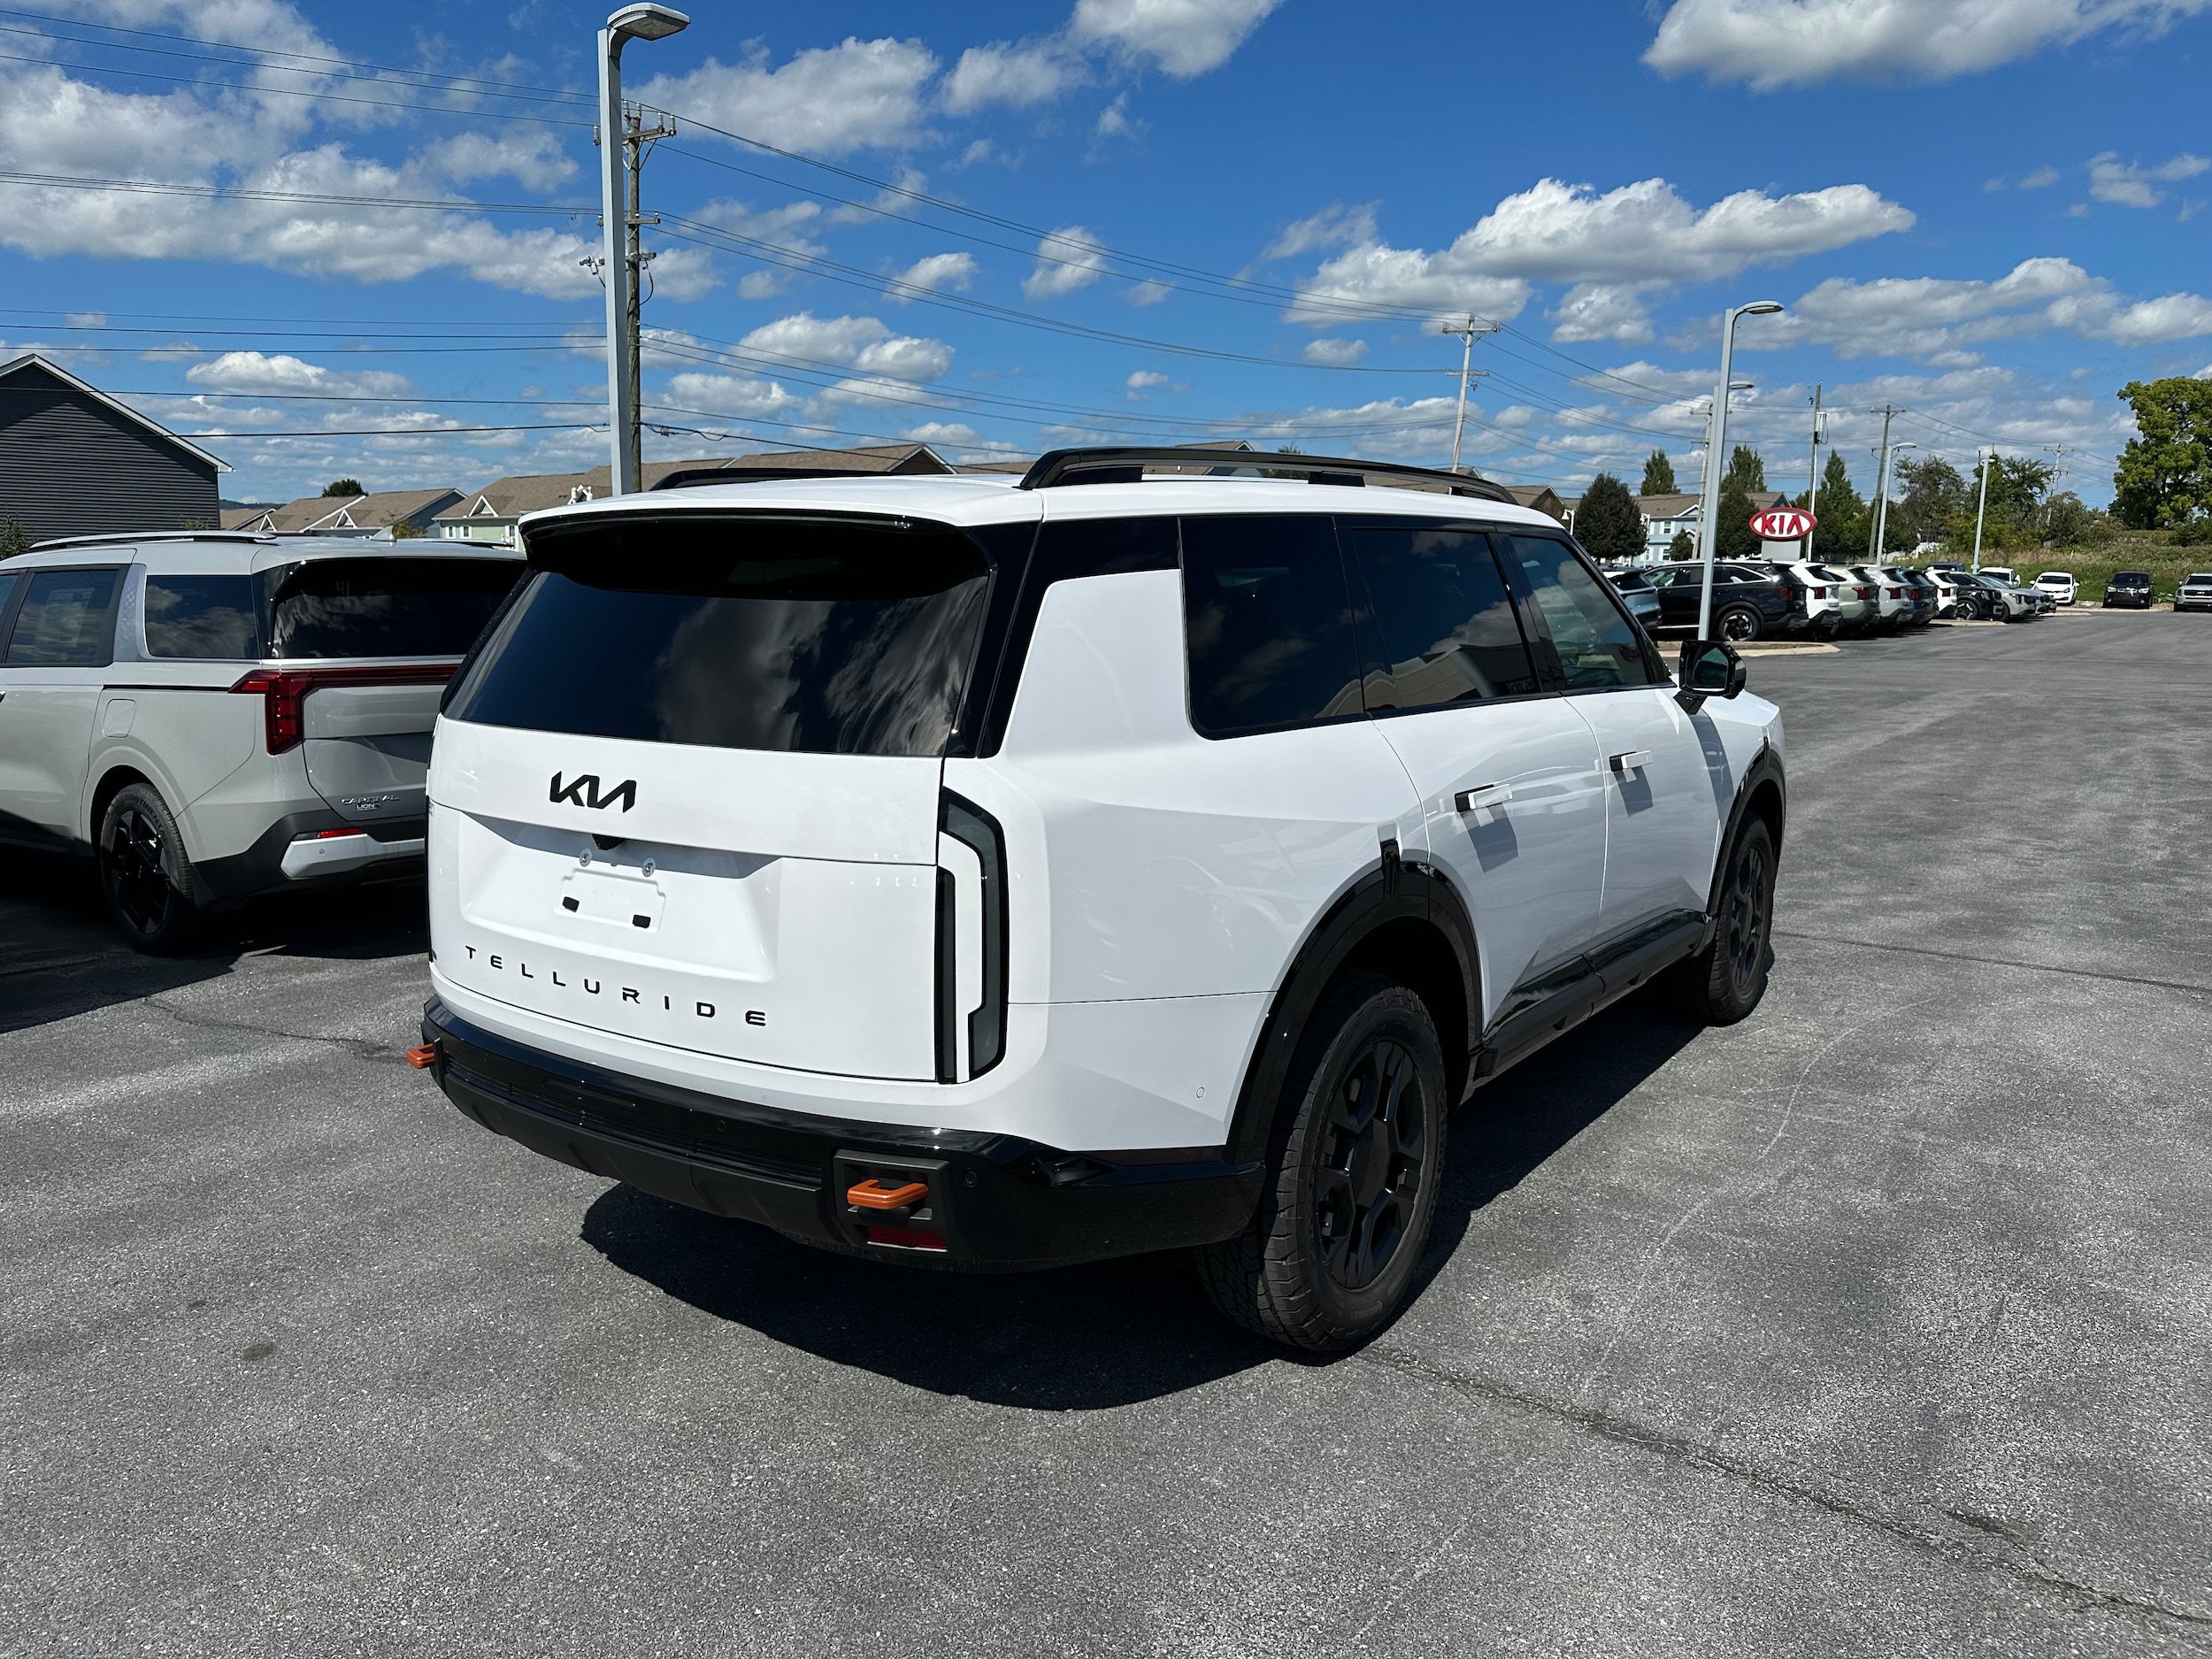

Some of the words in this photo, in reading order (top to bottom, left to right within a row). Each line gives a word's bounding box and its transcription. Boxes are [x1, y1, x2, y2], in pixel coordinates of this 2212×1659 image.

[1761, 514, 1804, 535] KIA
[549, 771, 637, 813] KIA
[465, 945, 766, 1027] TELLURIDE
